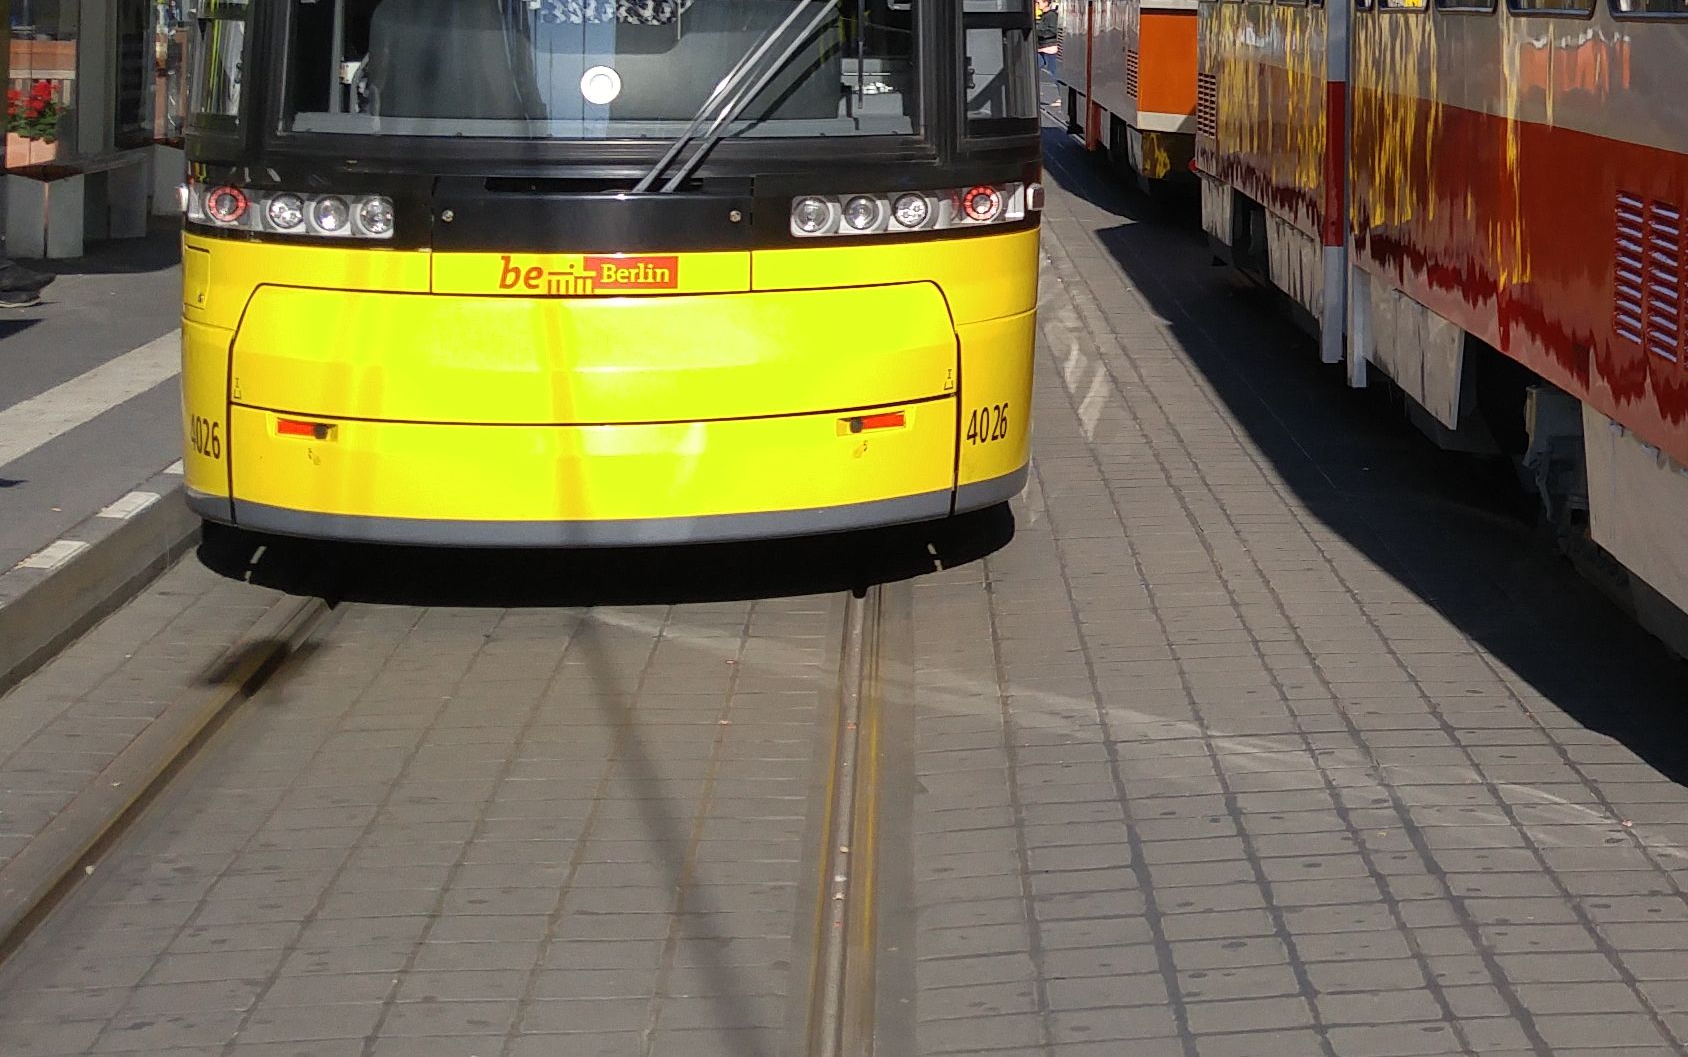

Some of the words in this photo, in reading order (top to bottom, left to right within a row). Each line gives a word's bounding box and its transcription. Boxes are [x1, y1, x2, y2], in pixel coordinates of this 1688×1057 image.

[499, 256, 544, 290] be
[601, 263, 670, 283] Berlin
[190, 414, 221, 459] 4026
[967, 403, 1009, 445] 4026
